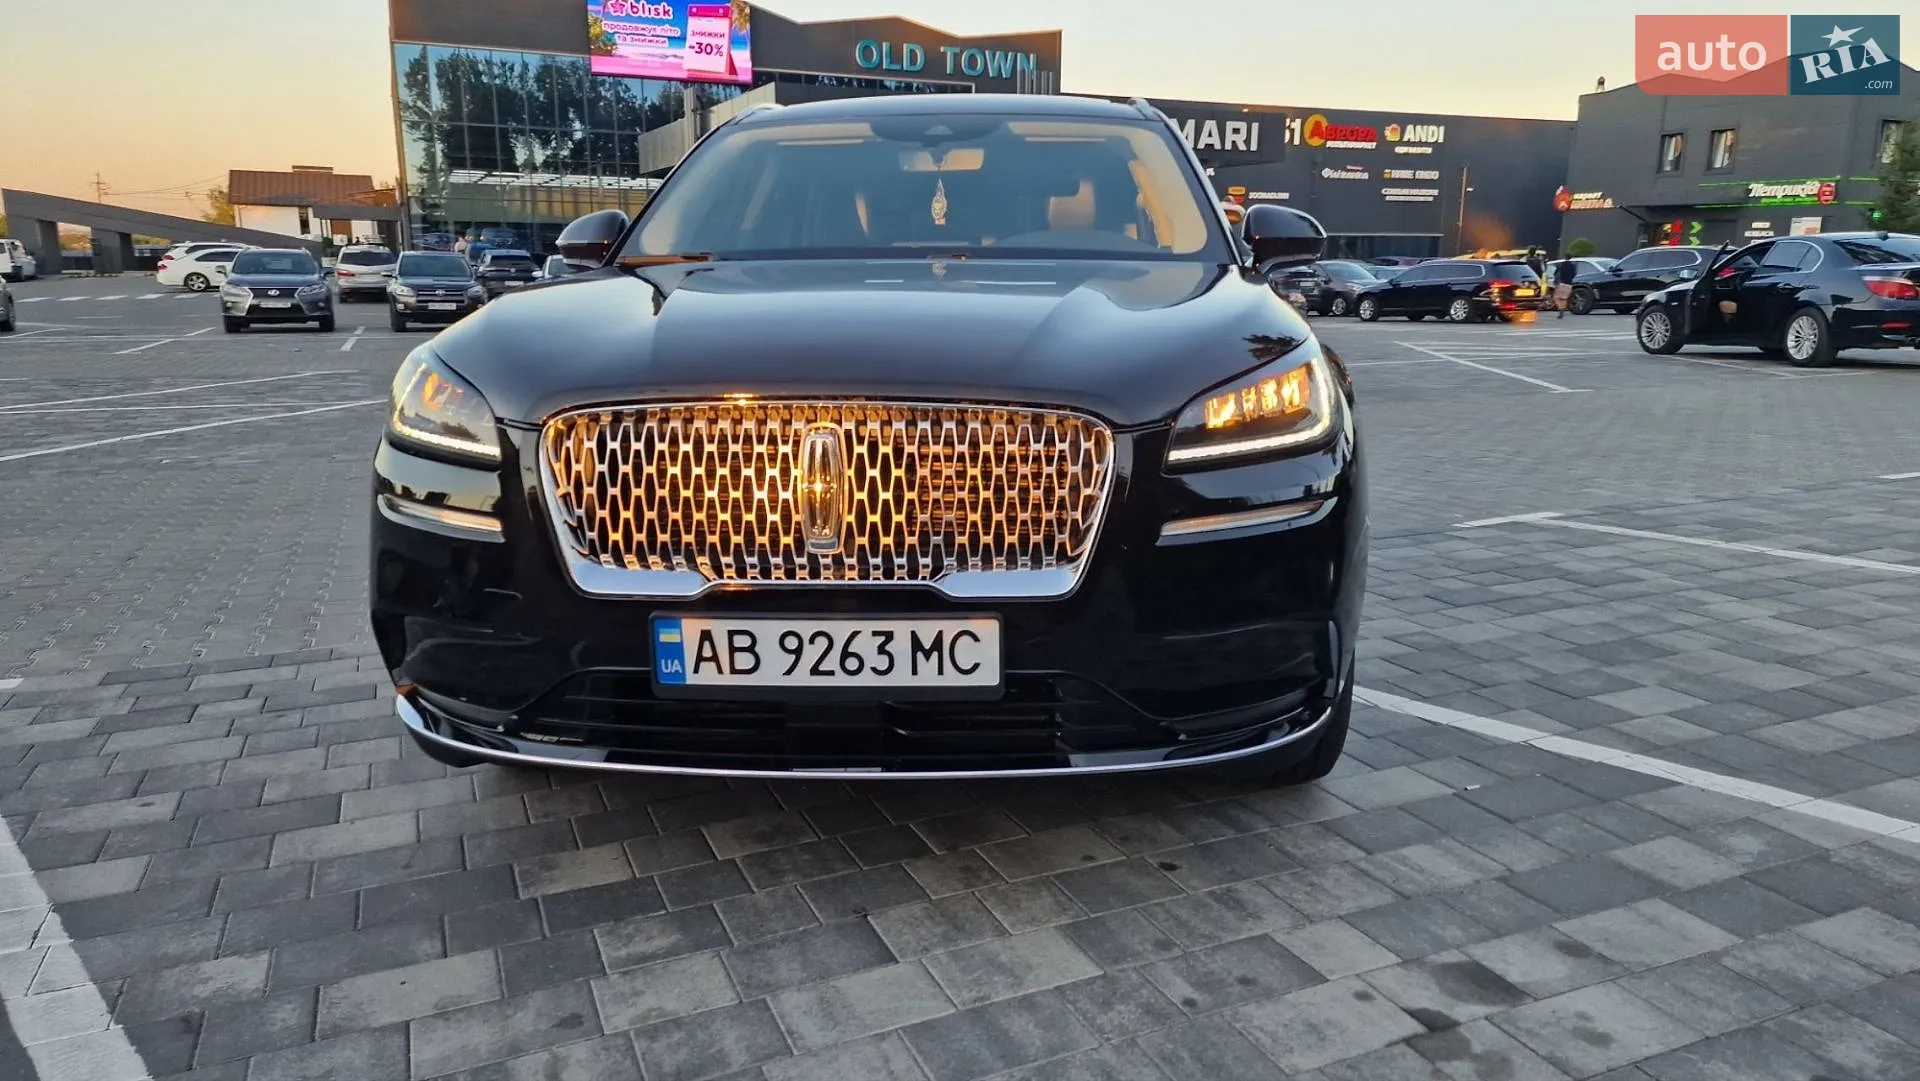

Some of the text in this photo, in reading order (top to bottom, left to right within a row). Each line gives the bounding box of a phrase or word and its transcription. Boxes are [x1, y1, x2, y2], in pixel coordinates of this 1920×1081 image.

[629, 1, 672, 18] blisk
[630, 36, 667, 46] знижки
[690, 30, 725, 39] знижки
[688, 41, 724, 57] -30%
[855, 39, 1037, 79] OLD TOWN
[1167, 118, 1260, 152] MARI
[693, 628, 982, 677] AB 9263 MC
[661, 658, 683, 675] UA
